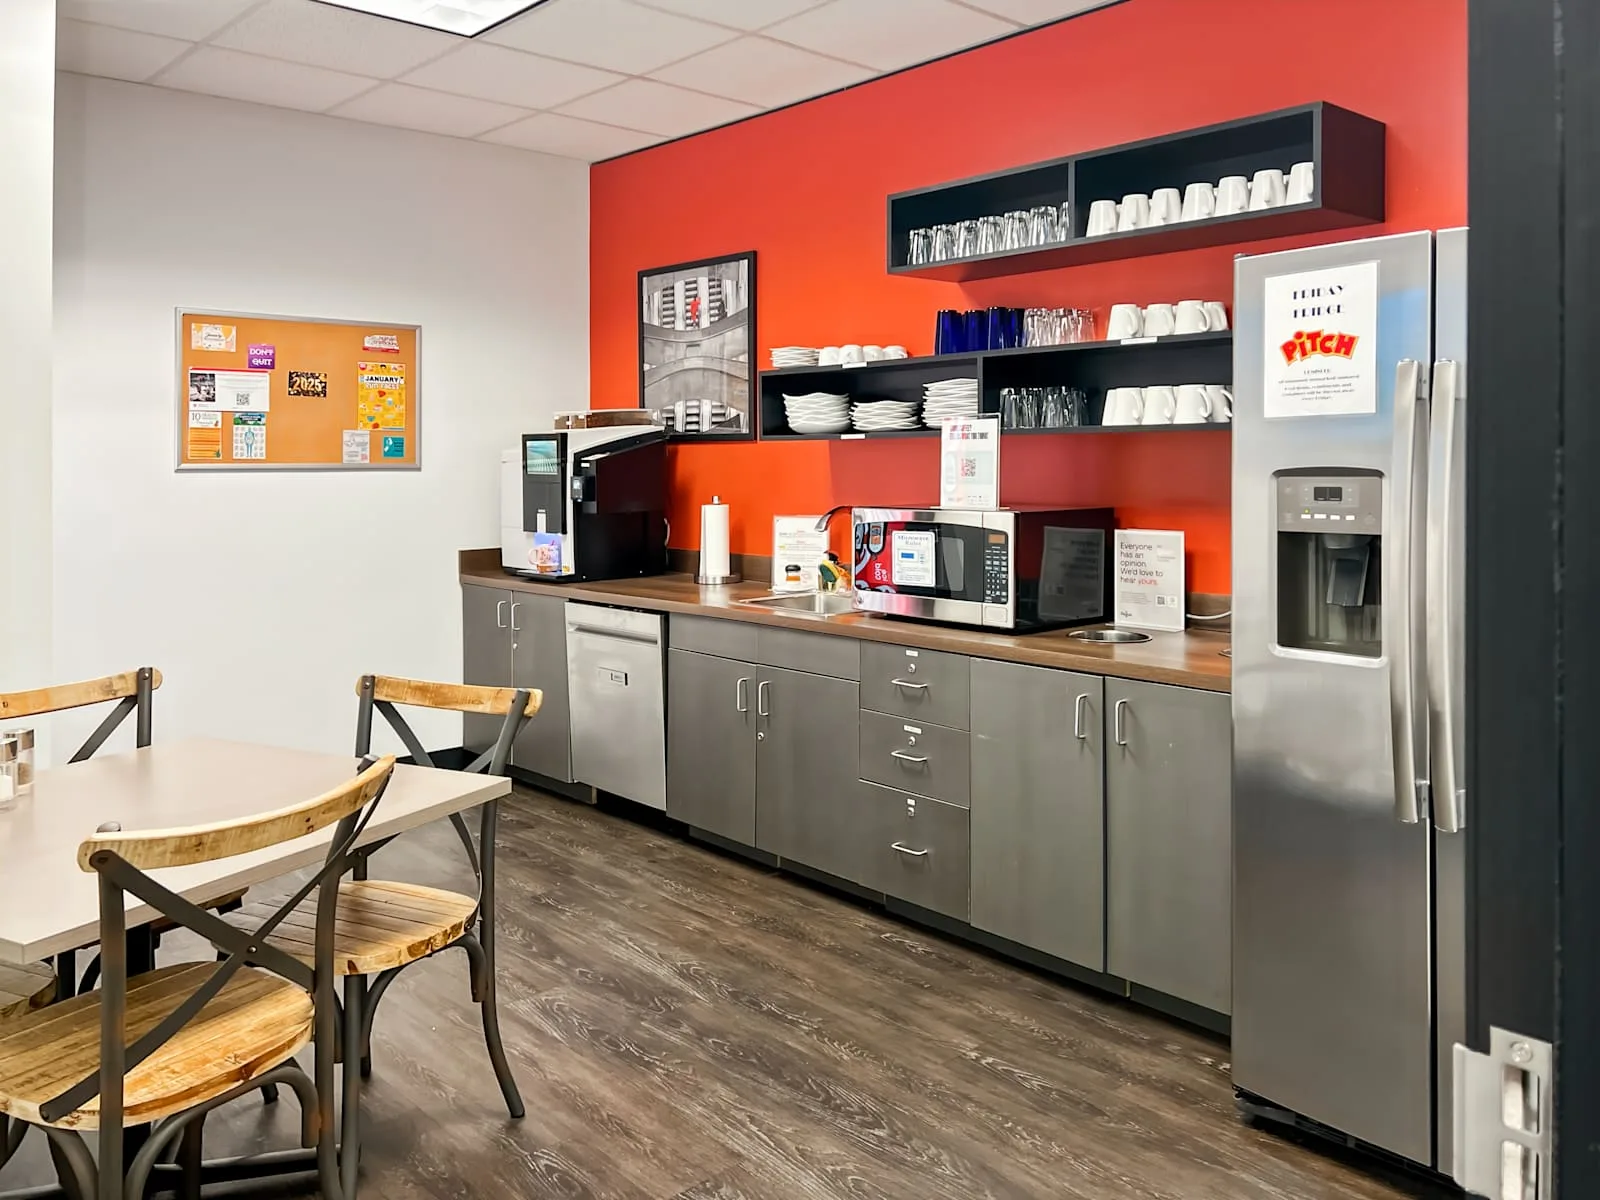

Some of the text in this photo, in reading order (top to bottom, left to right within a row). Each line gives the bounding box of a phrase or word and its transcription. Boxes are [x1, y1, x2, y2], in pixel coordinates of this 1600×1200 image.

[1293, 284, 1346, 300] FRIDAY
[251, 358, 273, 366] QUIT
[292, 376, 322, 391] 2025
[1120, 542, 1152, 551] Everyone
